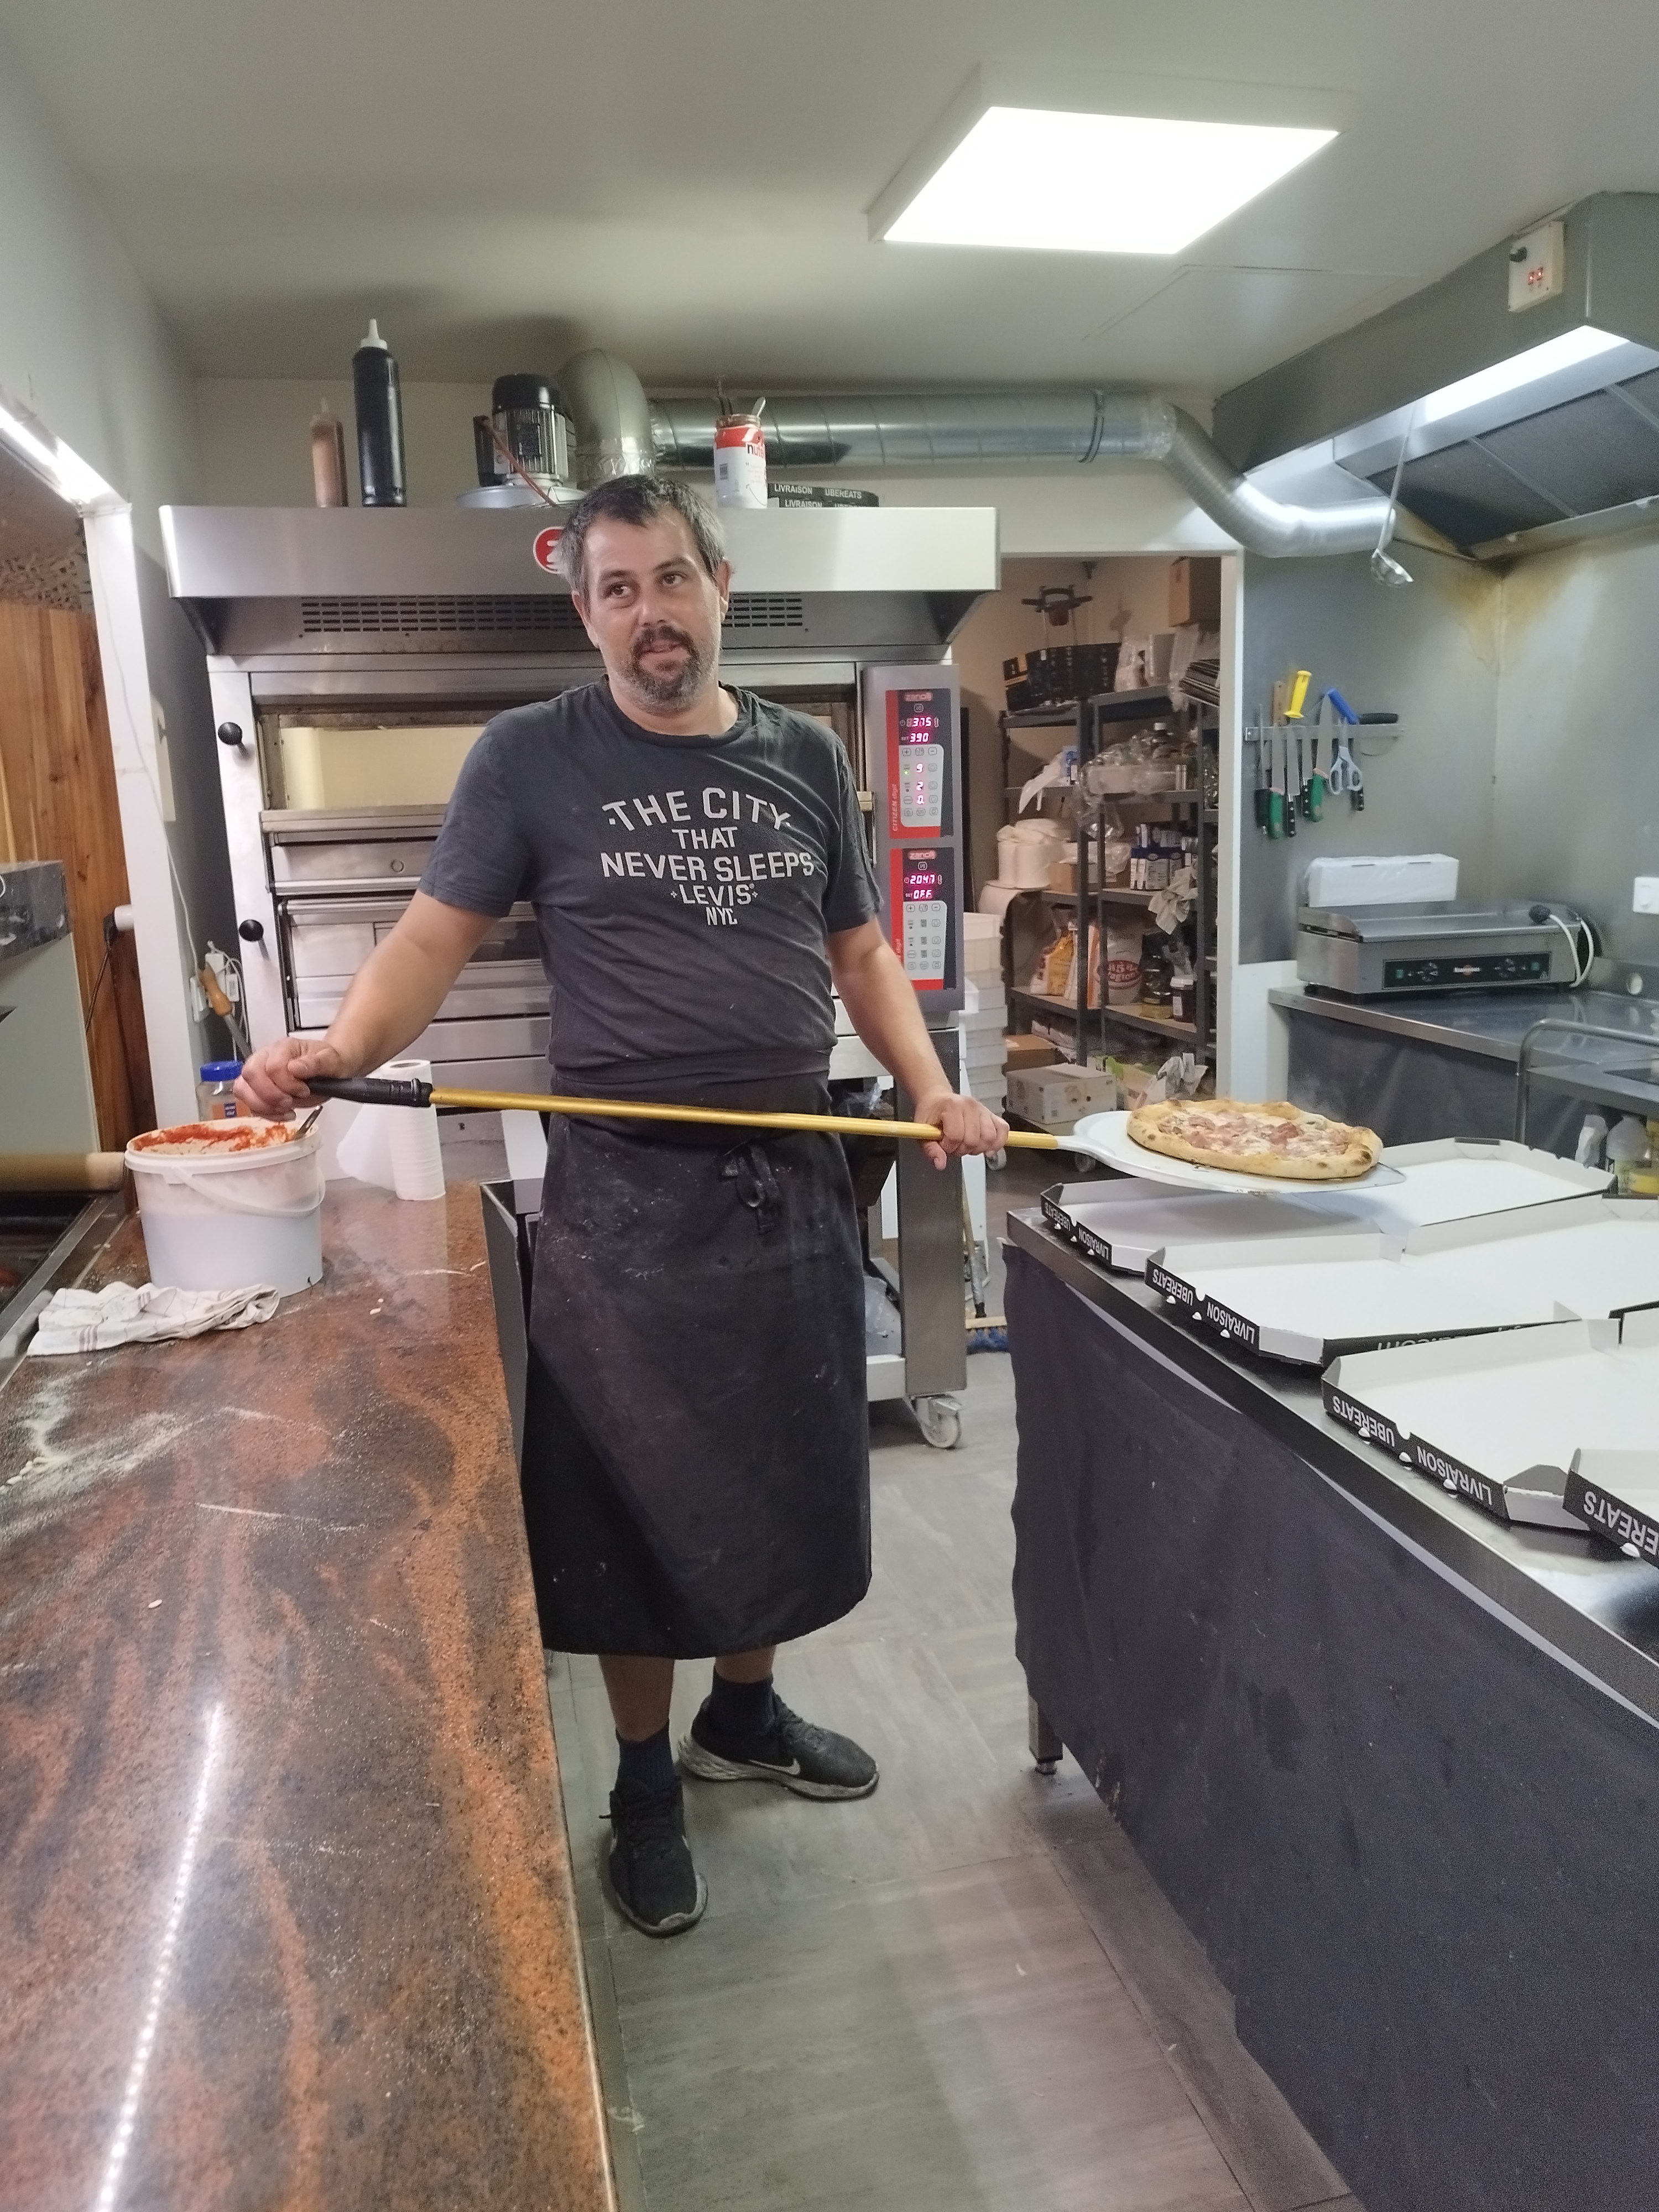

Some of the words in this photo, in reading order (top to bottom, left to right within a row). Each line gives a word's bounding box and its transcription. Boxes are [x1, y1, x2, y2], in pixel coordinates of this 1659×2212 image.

[774, 484, 813, 494] LIVRAISON
[825, 488, 862, 499] UBEREATS
[912, 717, 932, 727] 375
[910, 733, 929, 743] 390
[916, 781, 924, 791] 2
[602, 790, 691, 831] THE
[702, 787, 791, 831] CITY
[671, 826, 738, 849] THAT
[601, 852, 708, 881] NEVER
[713, 852, 815, 882] SLEEPS
[913, 889, 932, 899] OFF
[706, 907, 738, 926] NYC
[1078, 1227, 1109, 1260] LIVRAISON
[1152, 1269, 1193, 1306] UBEREATS
[1207, 1301, 1255, 1344] LIVRAISON
[1332, 1395, 1395, 1447] UBEREATS
[1417, 1445, 1493, 1506] LIVRAISON
[1583, 1491, 1659, 1556] EREATS
